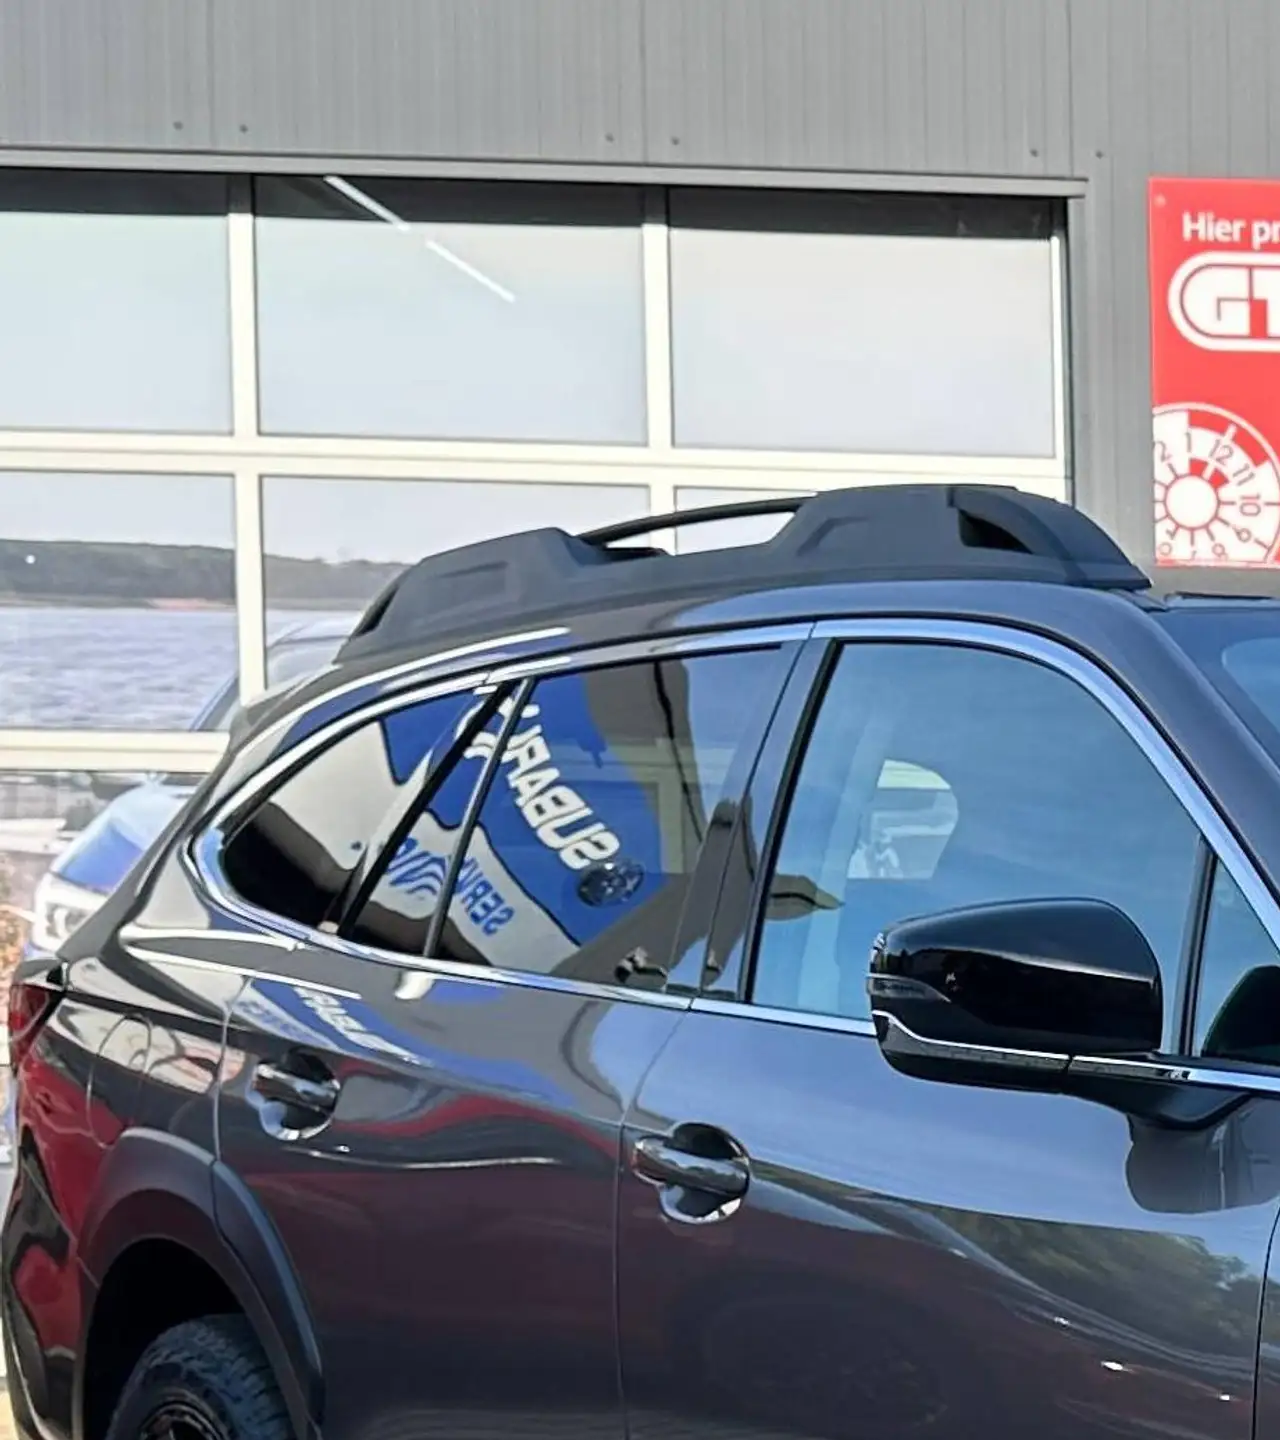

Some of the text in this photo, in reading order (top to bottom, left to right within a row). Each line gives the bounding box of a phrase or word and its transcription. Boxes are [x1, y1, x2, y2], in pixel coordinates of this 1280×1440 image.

[1182, 211, 1247, 242] Hier
[1208, 438, 1235, 467] 12
[1239, 492, 1262, 517] 10
